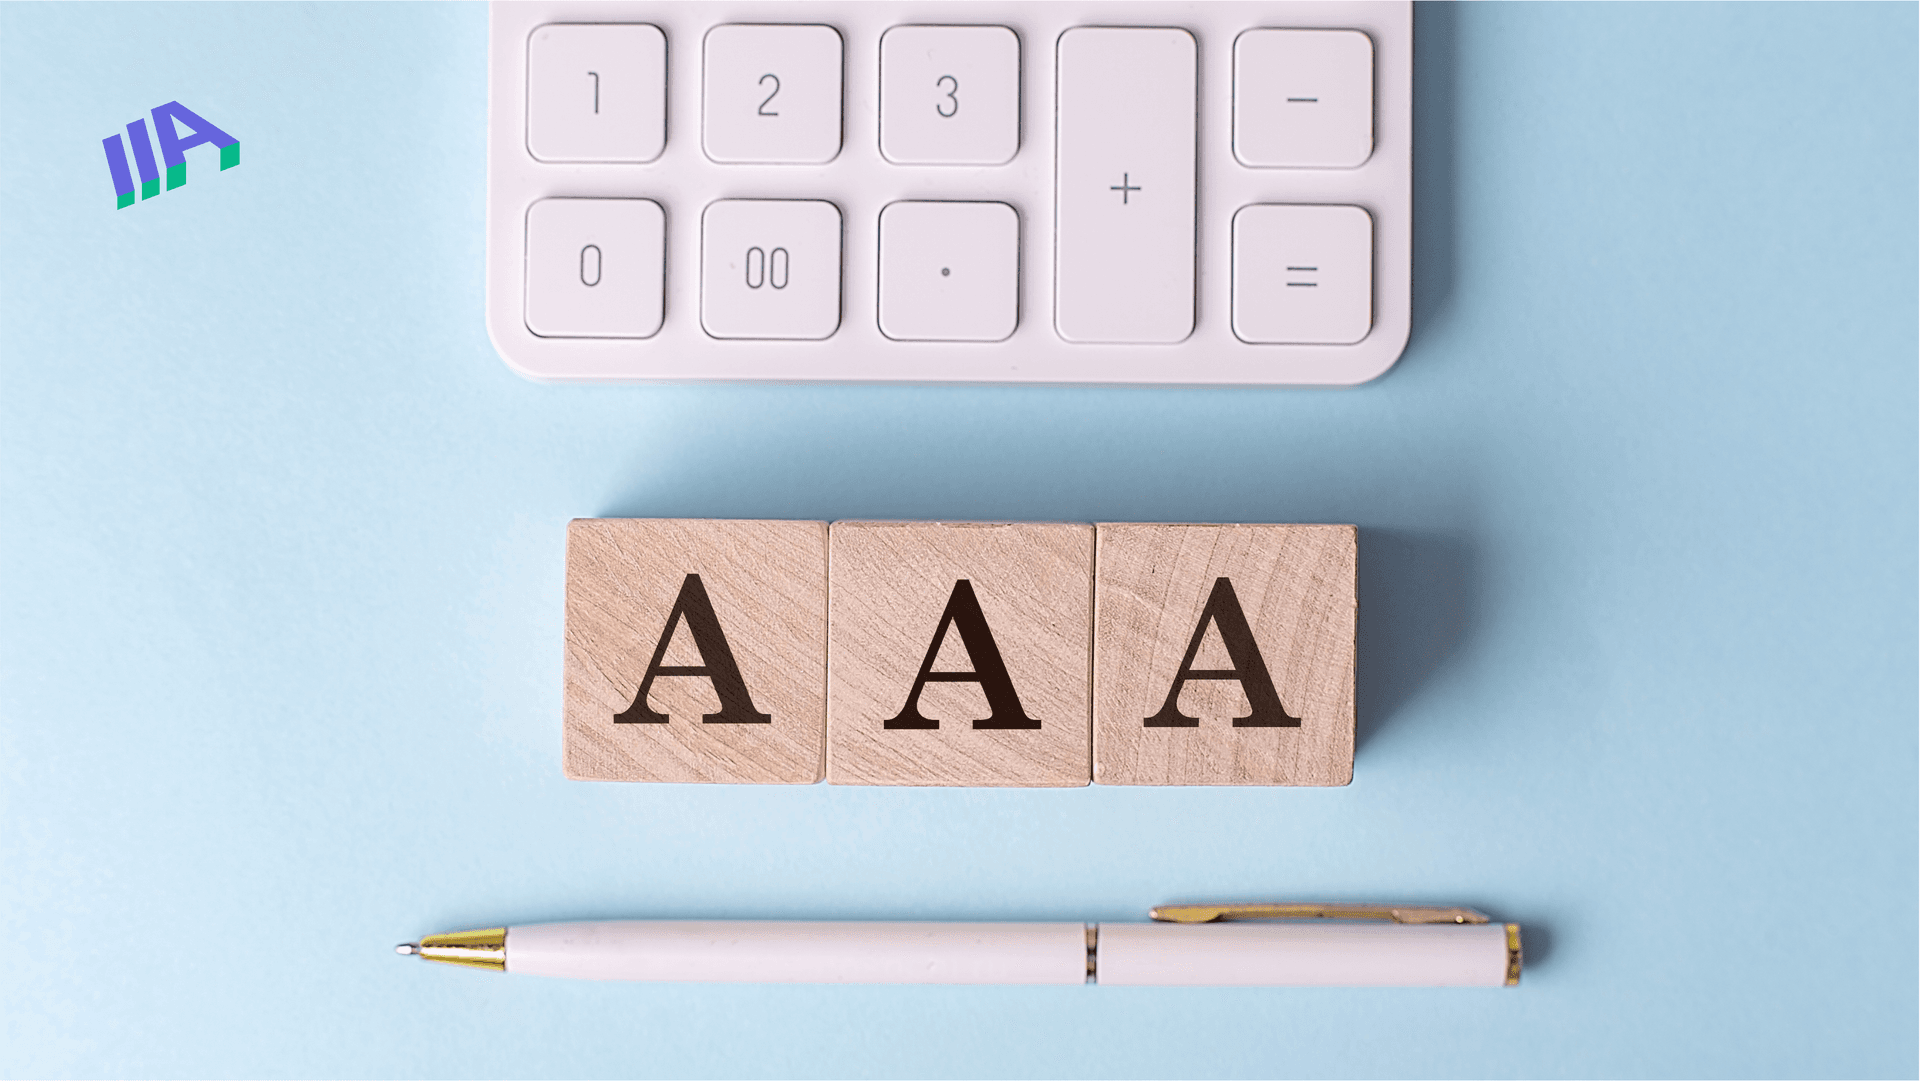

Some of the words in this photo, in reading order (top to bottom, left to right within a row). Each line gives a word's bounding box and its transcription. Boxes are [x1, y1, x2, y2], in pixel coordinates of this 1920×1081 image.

[757, 72, 781, 117] 2
[935, 74, 959, 119] 3
[579, 243, 603, 288] 0
[745, 245, 790, 291] 00
